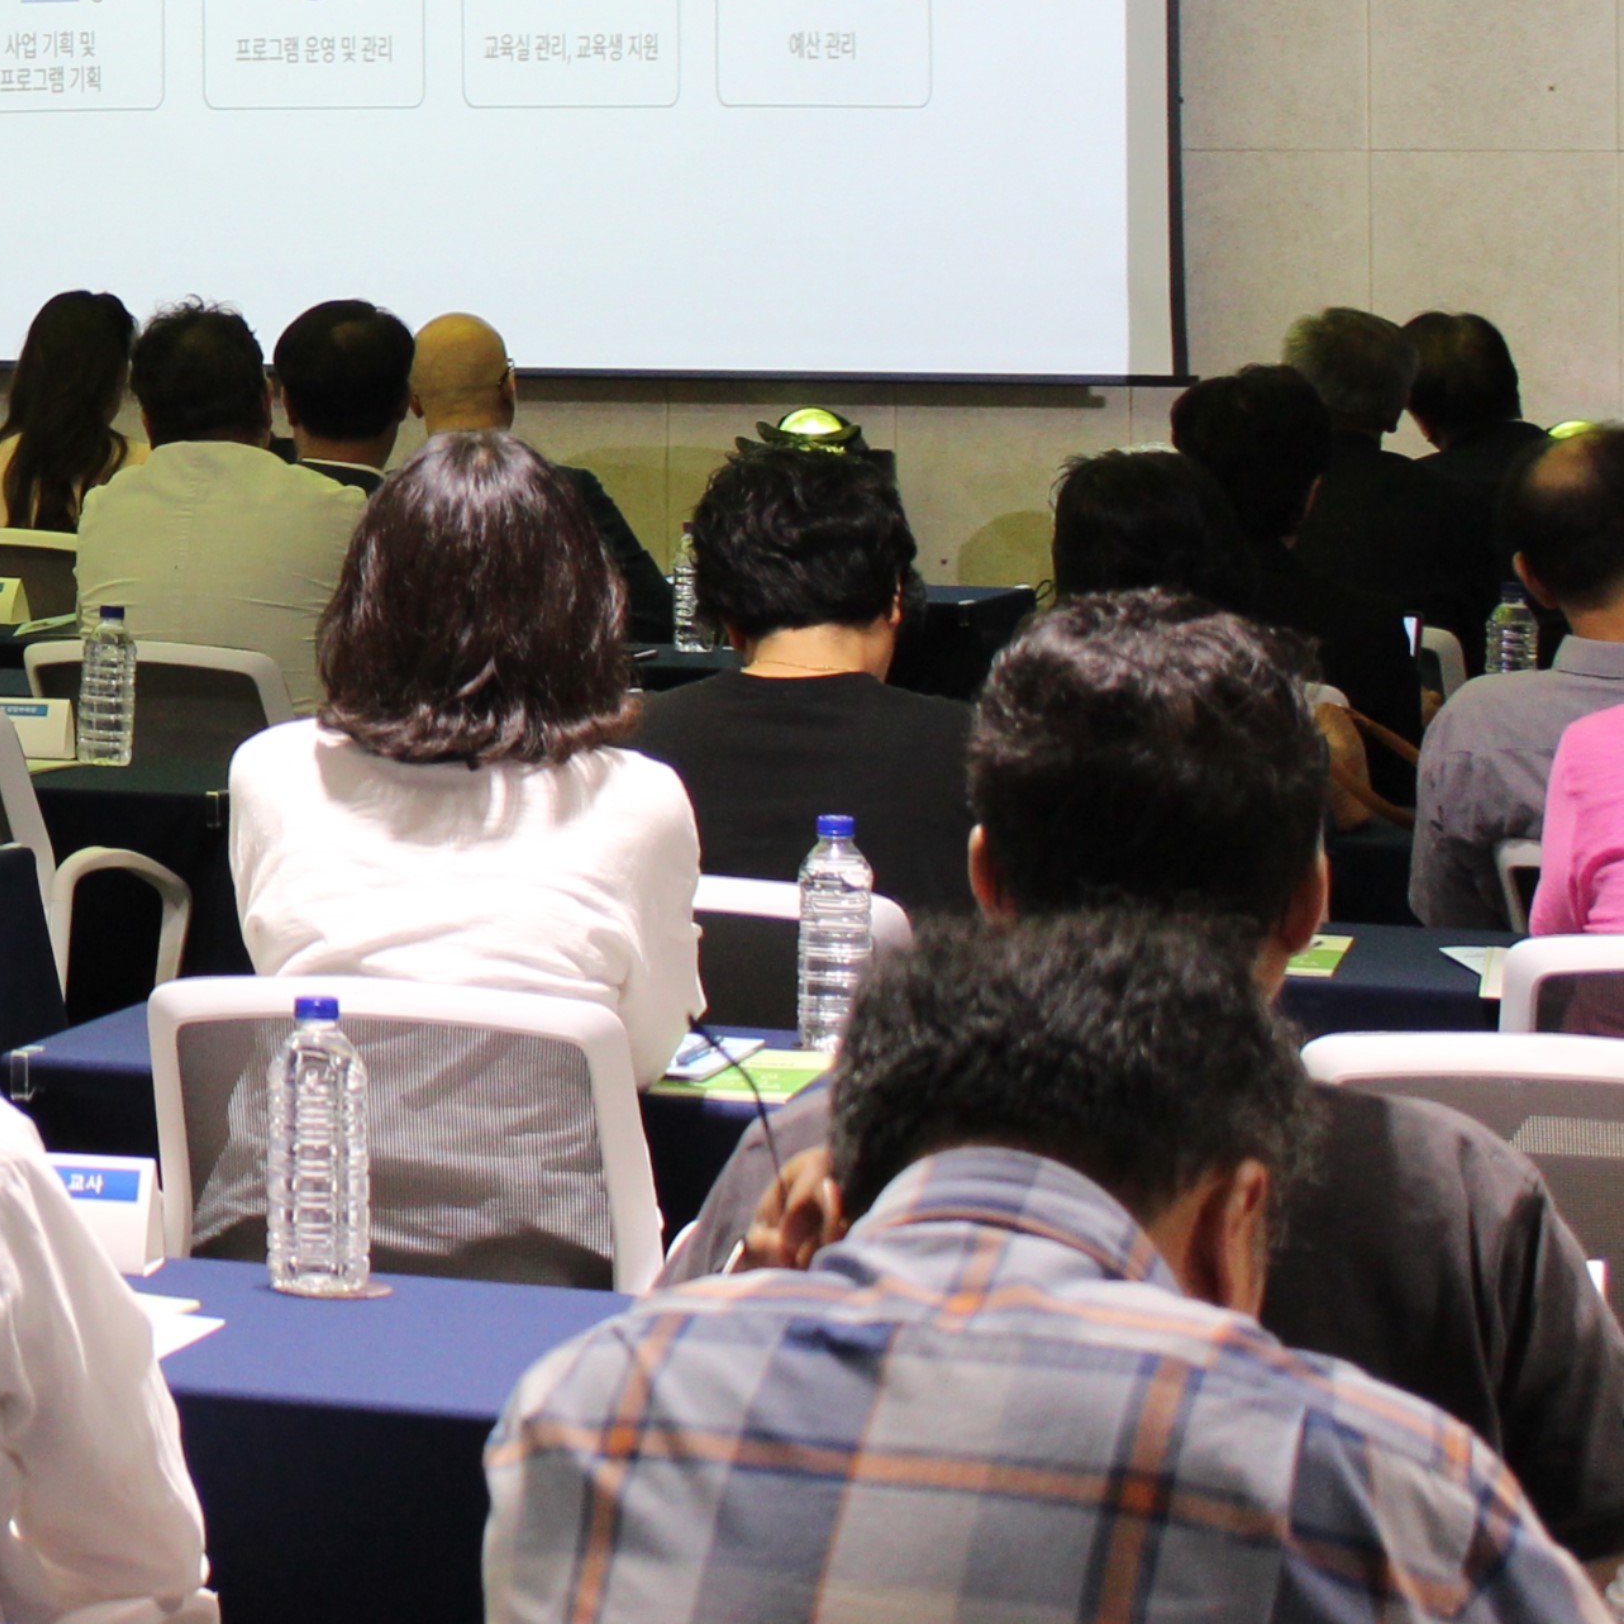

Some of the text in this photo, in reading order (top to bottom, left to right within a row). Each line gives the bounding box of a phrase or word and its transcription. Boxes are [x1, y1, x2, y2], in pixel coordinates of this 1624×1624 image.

[4, 31, 96, 59] 사업 기획 및
[235, 35, 392, 64] 프로그램 운영 및 관리
[483, 33, 531, 62] 교육실
[628, 33, 659, 62] 지원
[789, 31, 856, 60] 예산 관리
[0, 66, 102, 94] 프로그램 기획
